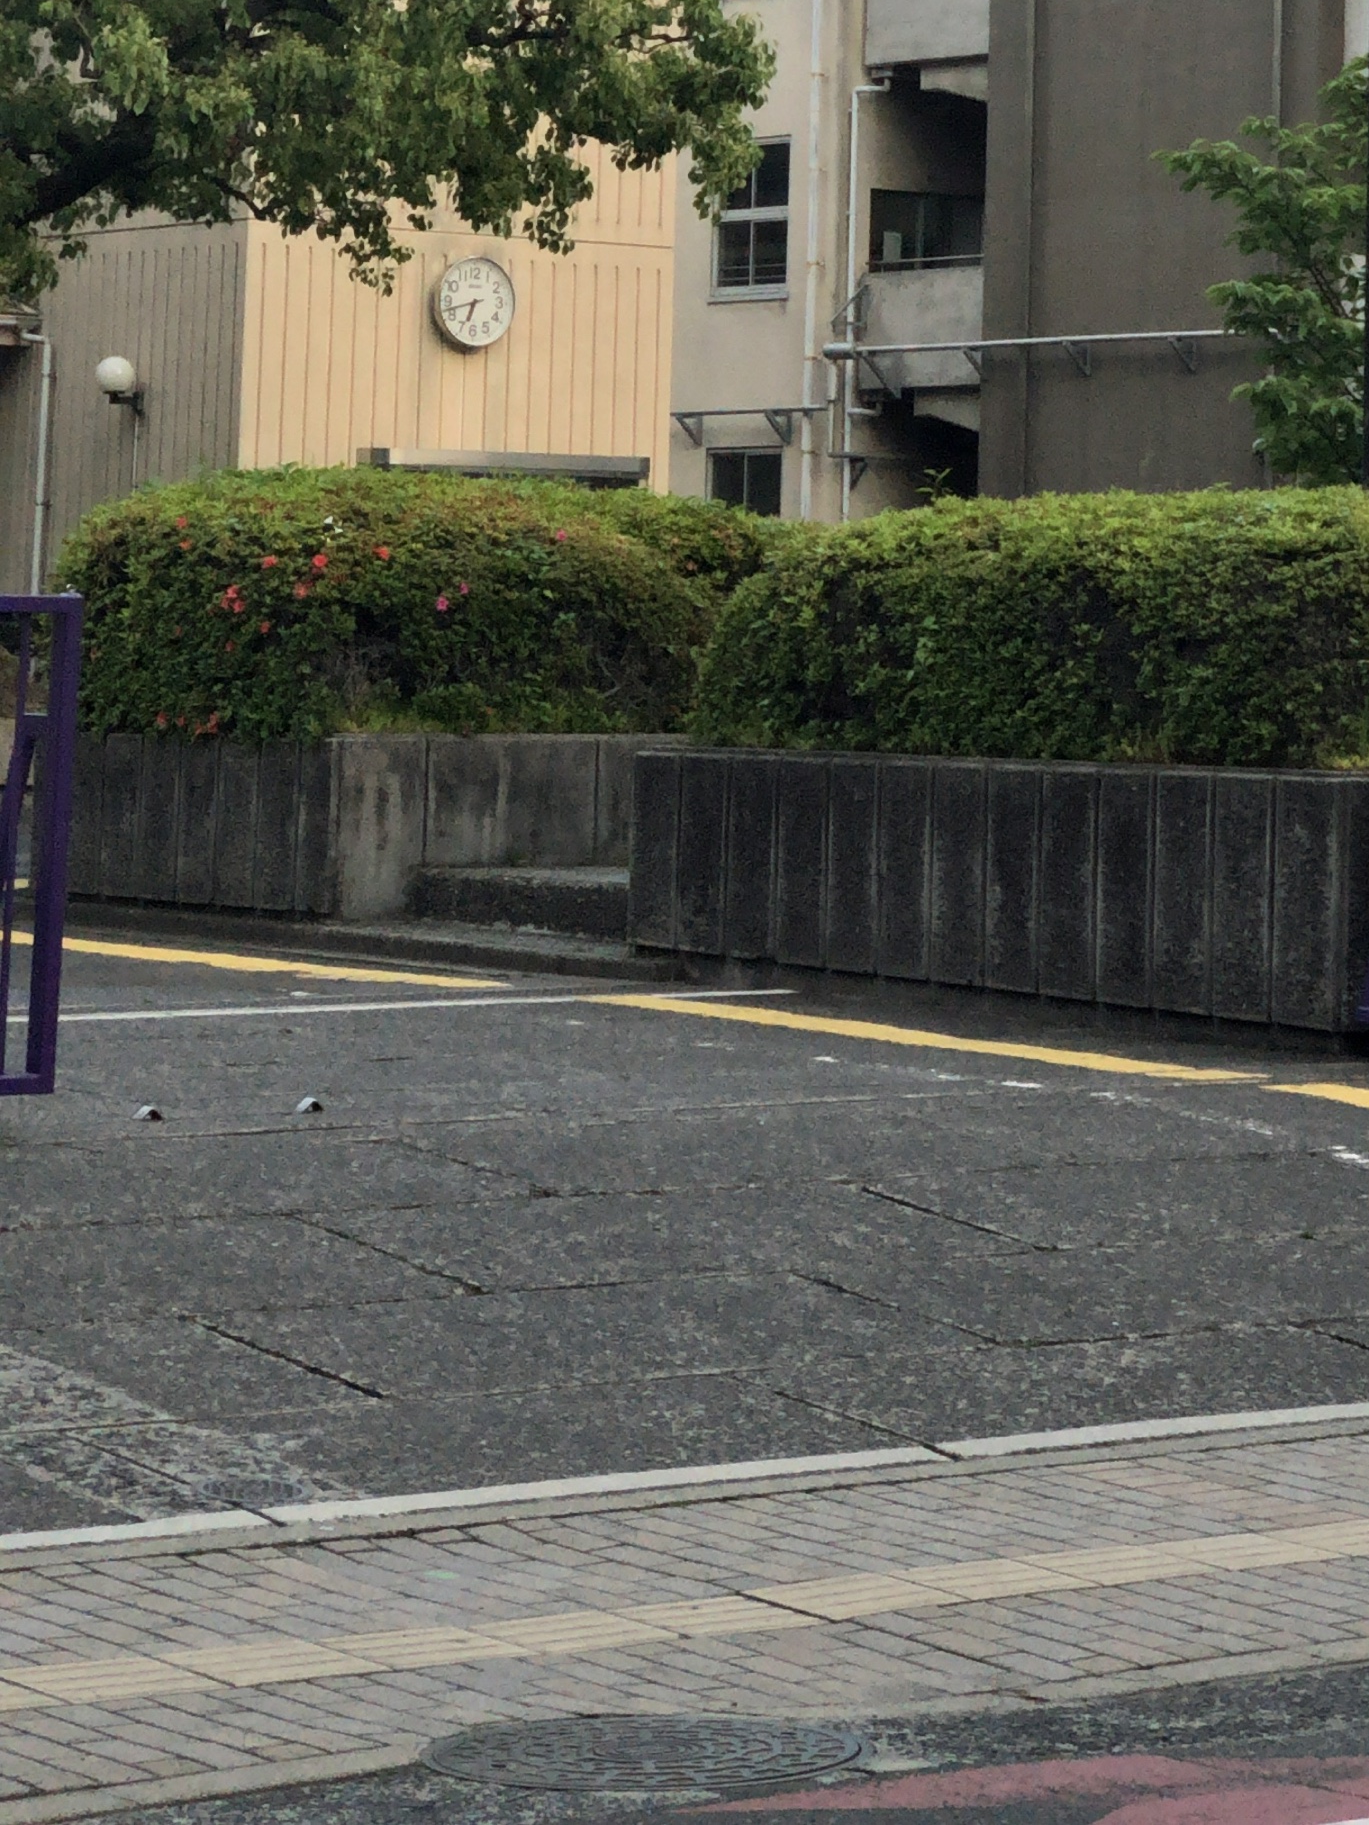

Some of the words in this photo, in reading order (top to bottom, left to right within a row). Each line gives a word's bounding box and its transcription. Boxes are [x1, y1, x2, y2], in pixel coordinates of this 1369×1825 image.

[470, 267, 481, 279] 12
[447, 280, 459, 293] 10
[492, 281, 501, 294] 2
[444, 295, 453, 307] 9
[495, 296, 504, 309] 3
[447, 309, 457, 321] 8
[491, 310, 500, 323] 4
[458, 321, 466, 333] 7
[468, 324, 477, 337] 6
[481, 321, 490, 334] 5
